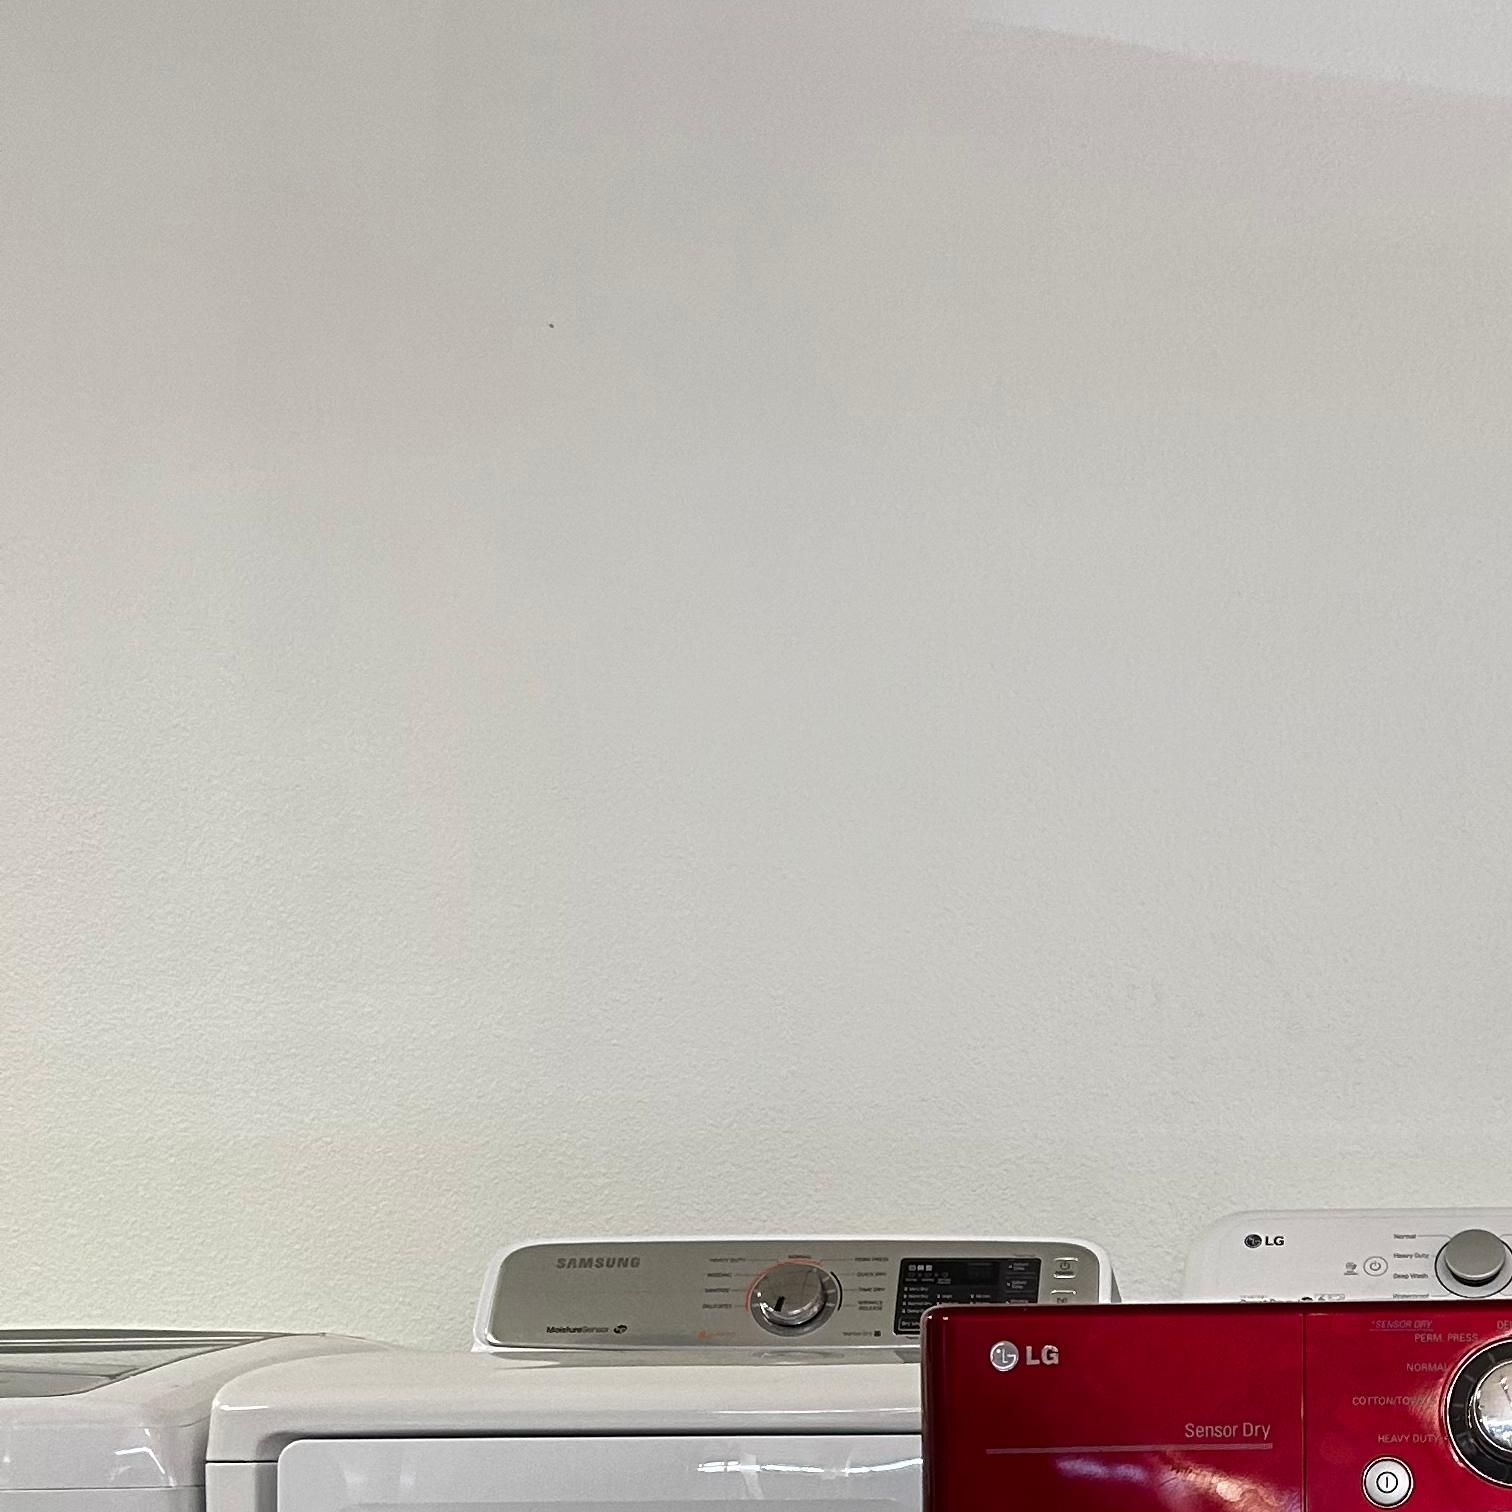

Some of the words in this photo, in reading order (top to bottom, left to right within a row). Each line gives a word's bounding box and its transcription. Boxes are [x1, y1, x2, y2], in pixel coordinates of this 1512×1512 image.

[1265, 1235, 1285, 1246] LG
[556, 1257, 641, 1269] SAMSUNG
[1447, 1332, 1479, 1342] PRESS
[1025, 1344, 1059, 1366] LG
[1406, 1362, 1449, 1372] NORMAL
[1184, 1422, 1239, 1438] Sensor
[1243, 1421, 1271, 1440] Dry
[1378, 1434, 1411, 1443] HEAVY
[1413, 1434, 1440, 1443] DUTY
